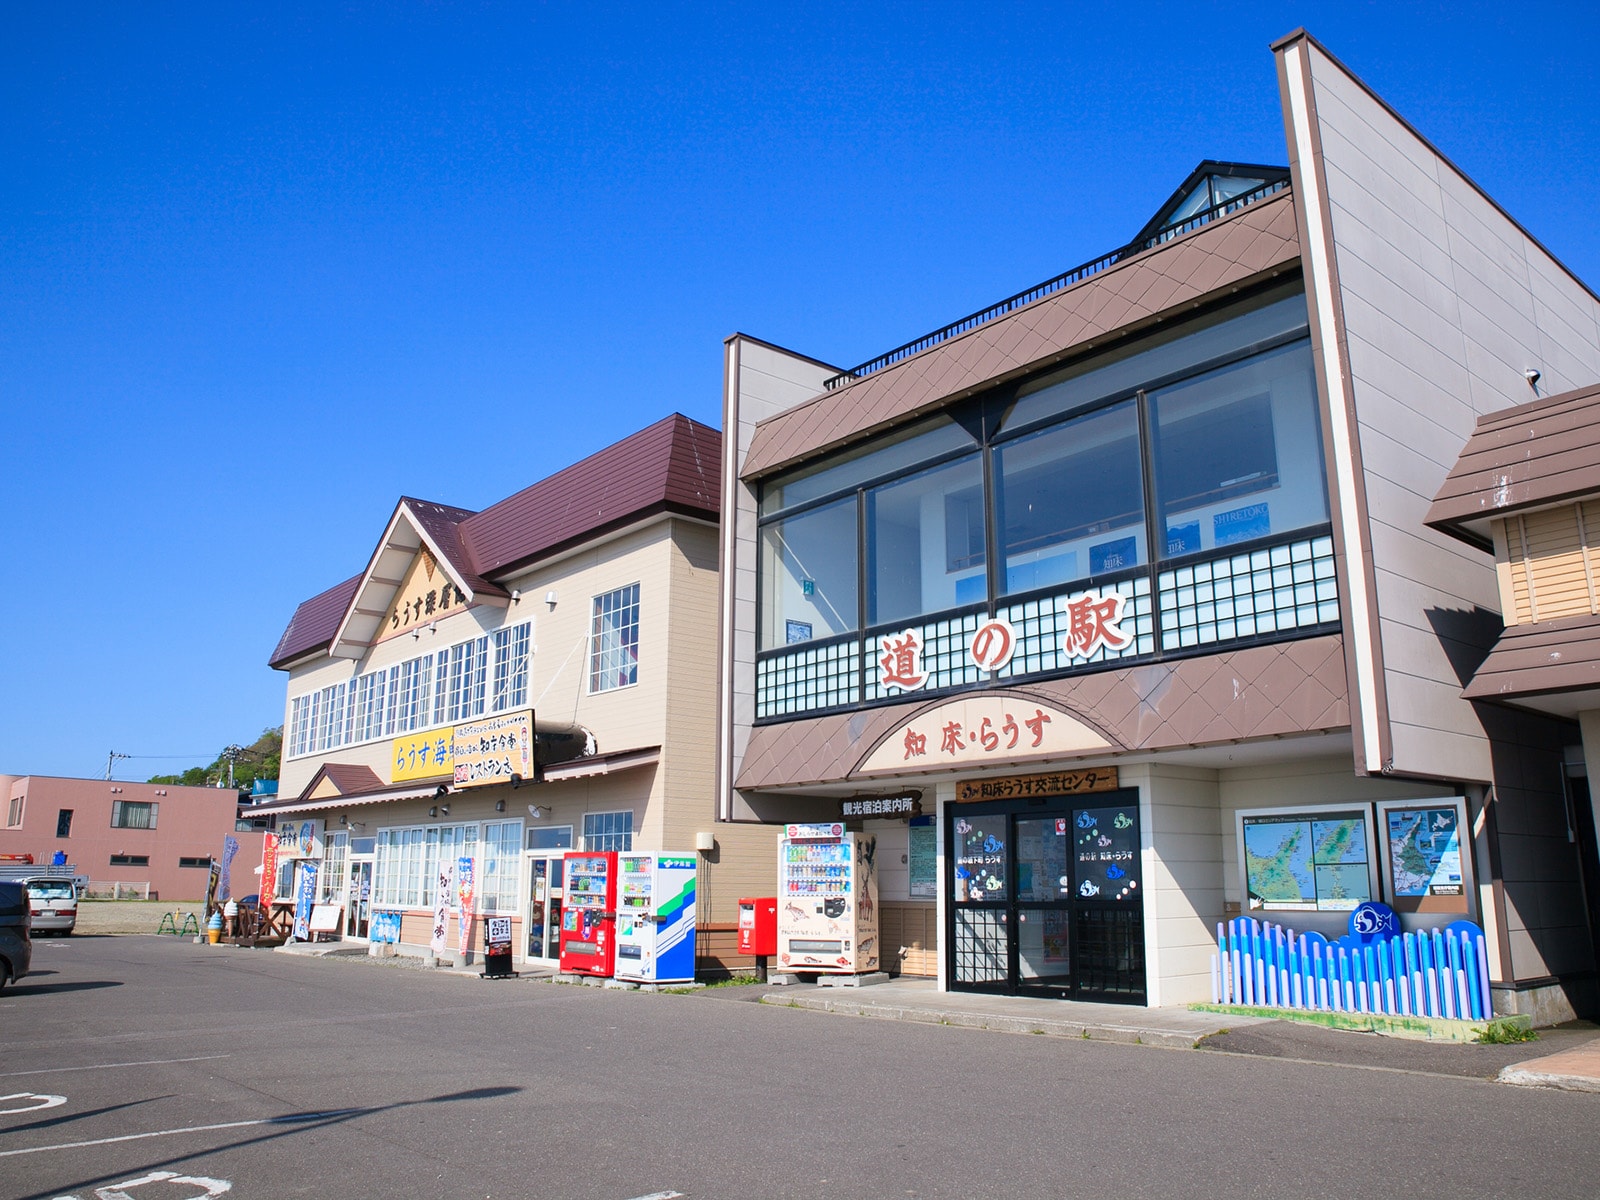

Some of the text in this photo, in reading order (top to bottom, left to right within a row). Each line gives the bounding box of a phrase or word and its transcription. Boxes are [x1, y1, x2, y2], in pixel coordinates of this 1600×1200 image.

[1214, 503, 1268, 526] SHIRETOKO
[981, 772, 1110, 798] 知床らうす交流センター
[843, 797, 913, 816] 観光宿泊案内所
